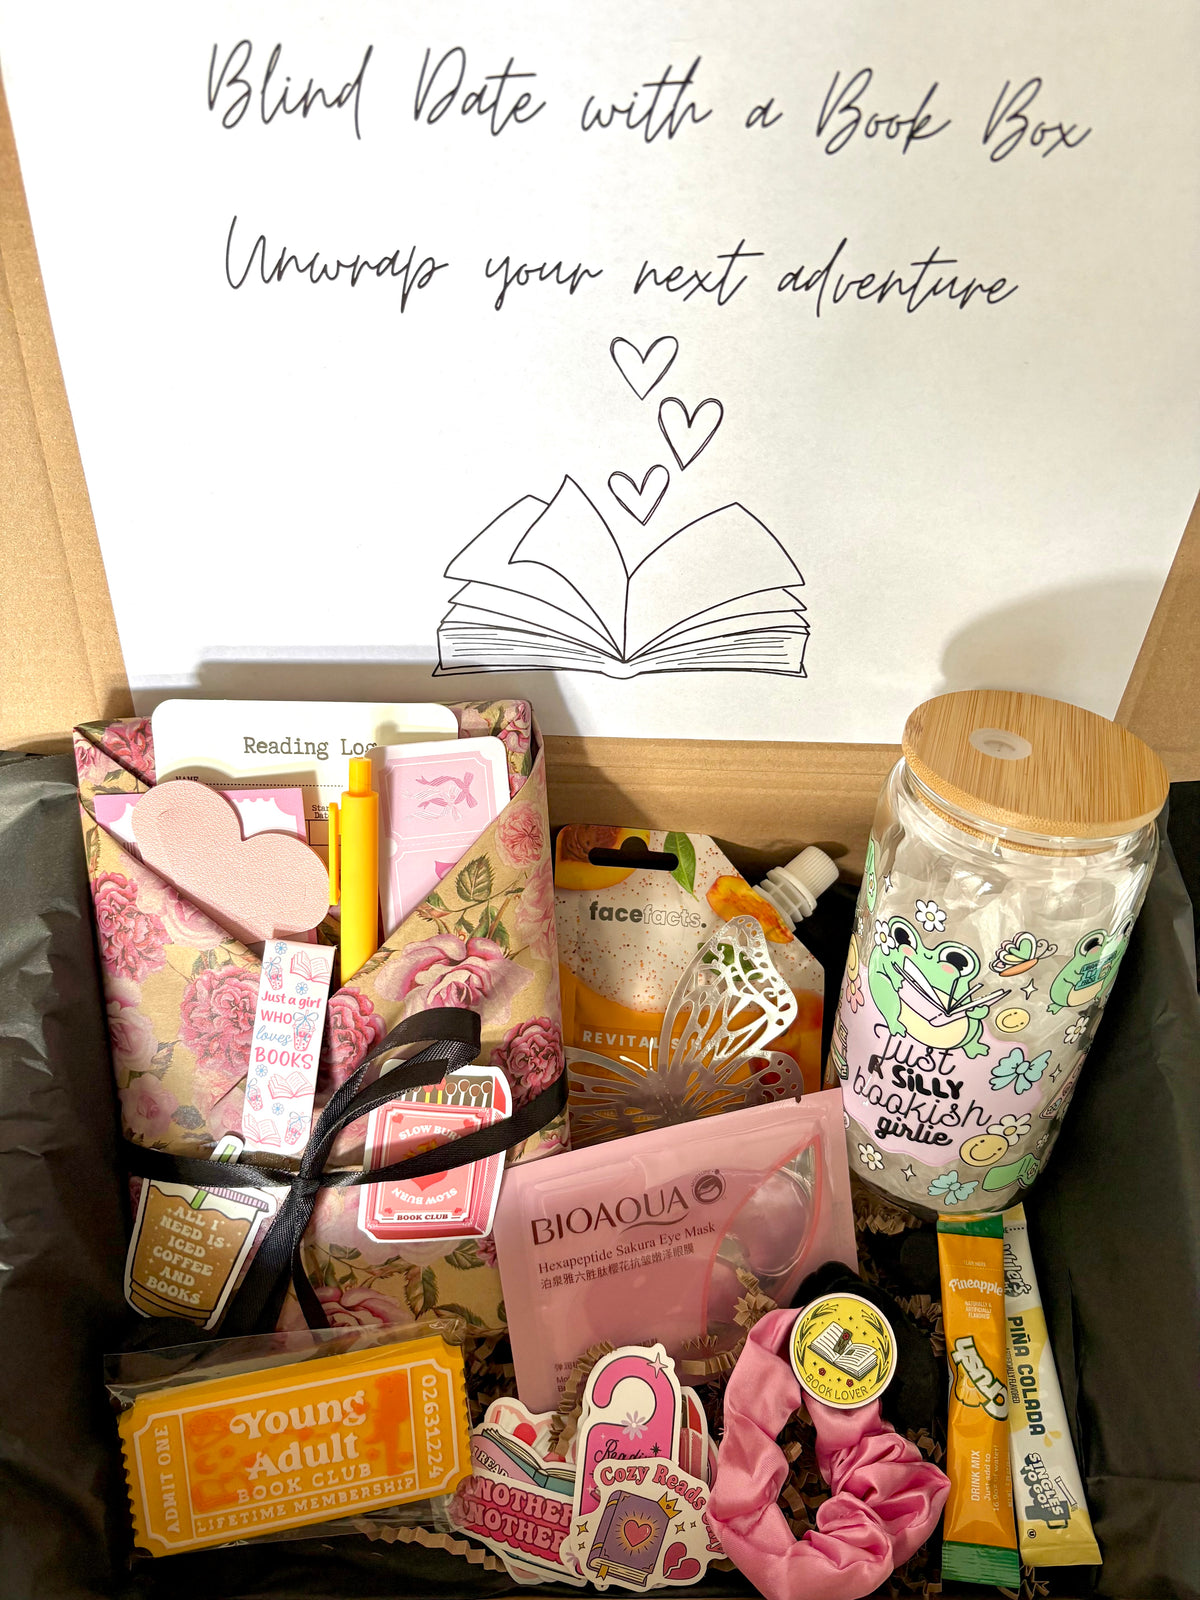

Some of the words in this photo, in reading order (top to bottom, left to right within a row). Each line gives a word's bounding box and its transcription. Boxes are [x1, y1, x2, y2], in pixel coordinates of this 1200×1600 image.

[208, 39, 373, 140] Blind
[414, 46, 547, 137] Date
[581, 55, 713, 143] with
[745, 97, 783, 128] a
[816, 67, 952, 155] Book
[983, 77, 1093, 162] Box
[226, 215, 450, 313] Unwrap
[485, 255, 603, 311] your
[634, 238, 764, 305] next
[777, 237, 1019, 317] adventure
[243, 736, 329, 760] Reading
[261, 990, 287, 1004] Just
[288, 996, 296, 1006] a
[298, 996, 321, 1010] girl
[260, 1009, 293, 1025] WHO
[256, 1025, 293, 1047] loves
[874, 1023, 956, 1075] Just
[254, 1046, 313, 1070] BOOKS
[853, 1065, 993, 1128] bookish
[398, 1124, 432, 1140] SLOW
[874, 1116, 953, 1146] girlie
[391, 1187, 424, 1205] BURN
[425, 1187, 458, 1205] SLOW
[173, 1206, 206, 1227] ALL
[210, 1219, 219, 1231] I
[531, 1185, 689, 1246] BIOAQUA
[159, 1216, 204, 1241] NEED
[206, 1233, 225, 1248] IS
[167, 1235, 206, 1258] ICED
[538, 1249, 613, 1274] Hexapeptide
[616, 1237, 656, 1257] Sakura
[659, 1232, 682, 1247] Eye
[684, 1221, 716, 1238] Mask
[153, 1246, 214, 1277] COFFEE
[159, 1266, 196, 1287] AND
[146, 1276, 201, 1305] BOOKS
[949, 1278, 1004, 1296] Pineapple
[1008, 1316, 1031, 1357] PIÑA
[805, 1373, 832, 1398] BOOK
[834, 1386, 869, 1400] LOVER
[1017, 1364, 1046, 1436] COLADA
[229, 1390, 366, 1440] Young
[421, 1374, 444, 1479] 02631224
[154, 1425, 171, 1466] ONE
[248, 1432, 360, 1480] Adult
[971, 1450, 980, 1469] MIX
[984, 1453, 991, 1462] to
[236, 1477, 303, 1505] BOOK
[311, 1463, 373, 1487] CLUB
[600, 1466, 650, 1486] Cozy
[652, 1464, 707, 1511] Reads
[971, 1471, 980, 1502] DRINK
[983, 1483, 991, 1501] Just
[1025, 1465, 1038, 1482] TO
[1033, 1483, 1050, 1509] GO!
[1029, 1452, 1064, 1516] SINGLES
[160, 1473, 180, 1533] ADMIT
[196, 1504, 287, 1533] LIFETIME
[294, 1477, 415, 1513] MEMBERSHIP
